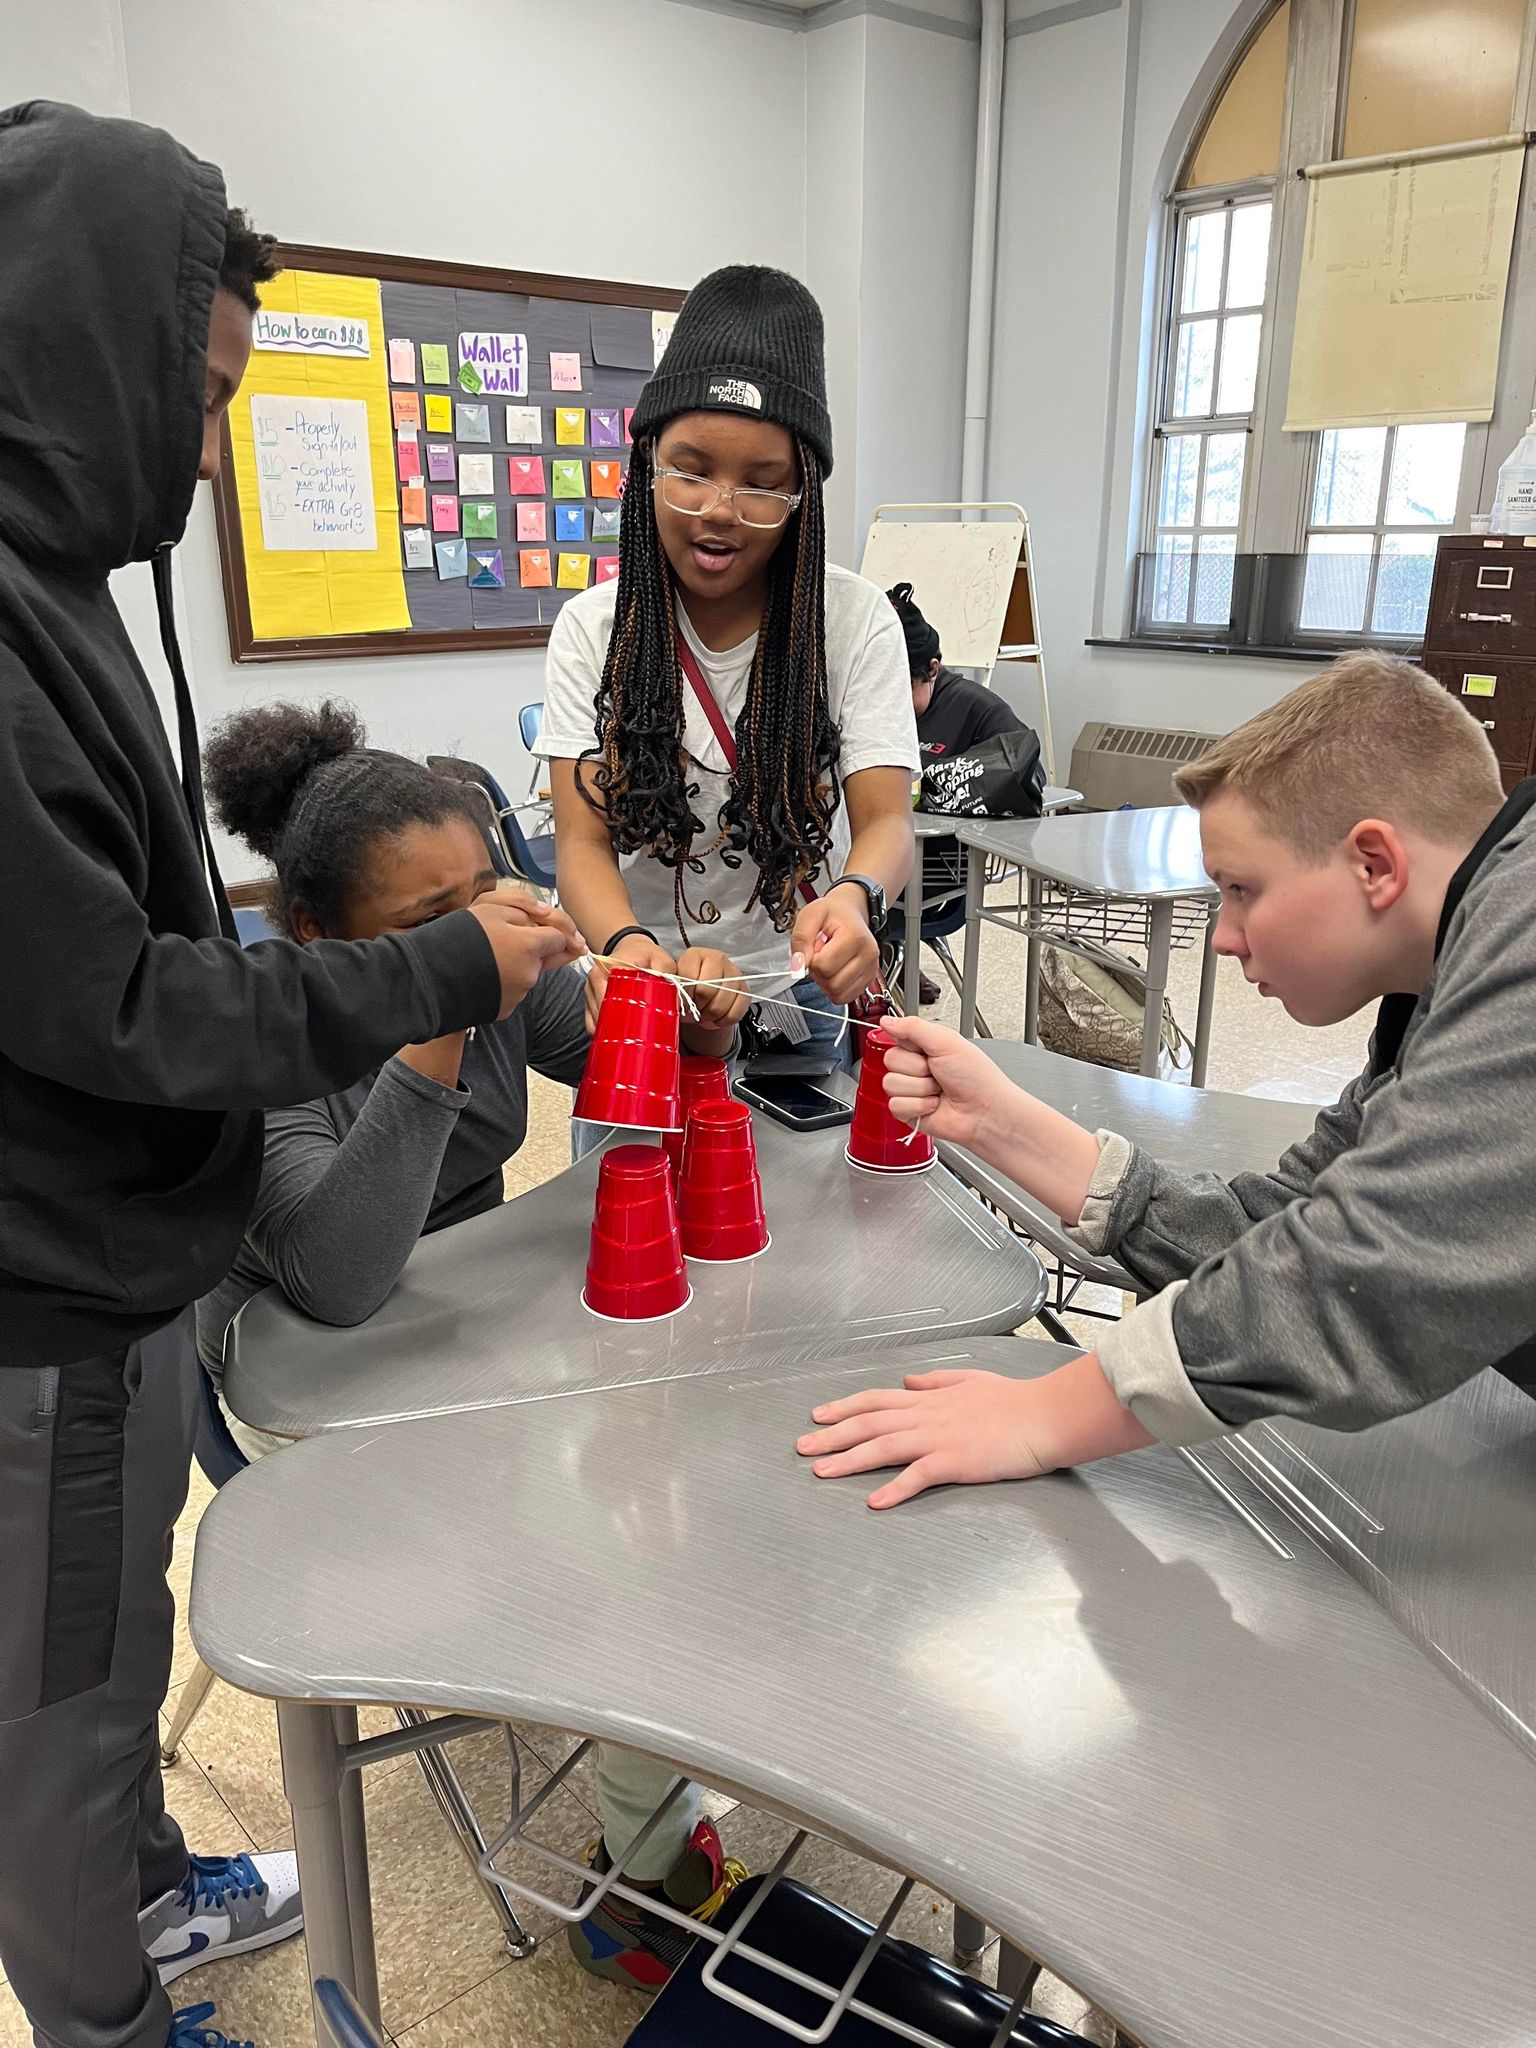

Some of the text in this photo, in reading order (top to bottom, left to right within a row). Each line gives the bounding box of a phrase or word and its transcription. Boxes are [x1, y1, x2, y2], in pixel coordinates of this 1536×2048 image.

[256, 312, 292, 339] How
[294, 316, 309, 340] to
[311, 326, 337, 341] earn
[460, 334, 524, 365] Wallet
[483, 367, 520, 393] Wall
[727, 379, 747, 389] THE
[709, 385, 745, 397] NORTH
[717, 393, 744, 405] FACE
